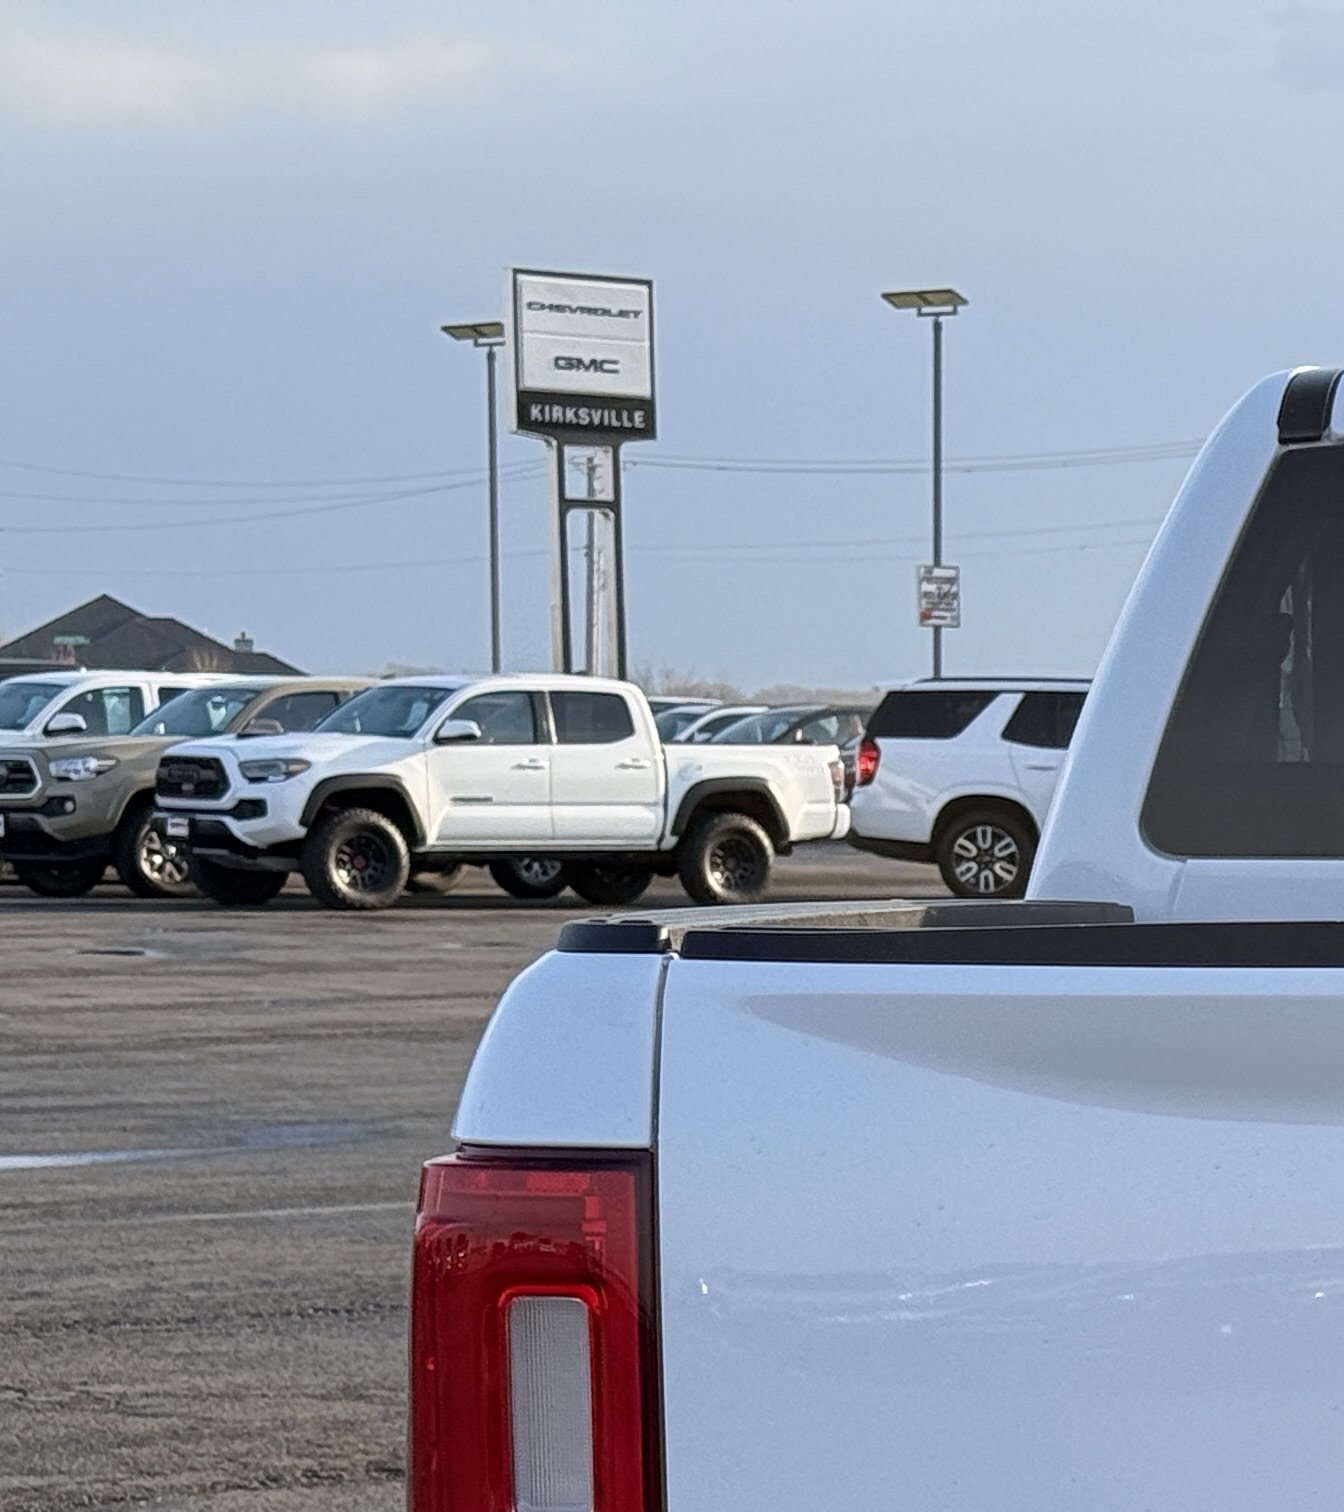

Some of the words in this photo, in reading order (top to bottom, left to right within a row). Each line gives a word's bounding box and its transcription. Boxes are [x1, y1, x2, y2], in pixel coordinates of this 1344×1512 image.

[526, 301, 643, 320] CHEVROLET
[554, 356, 620, 374] GMC
[530, 403, 645, 428] KIRKSVILLE
